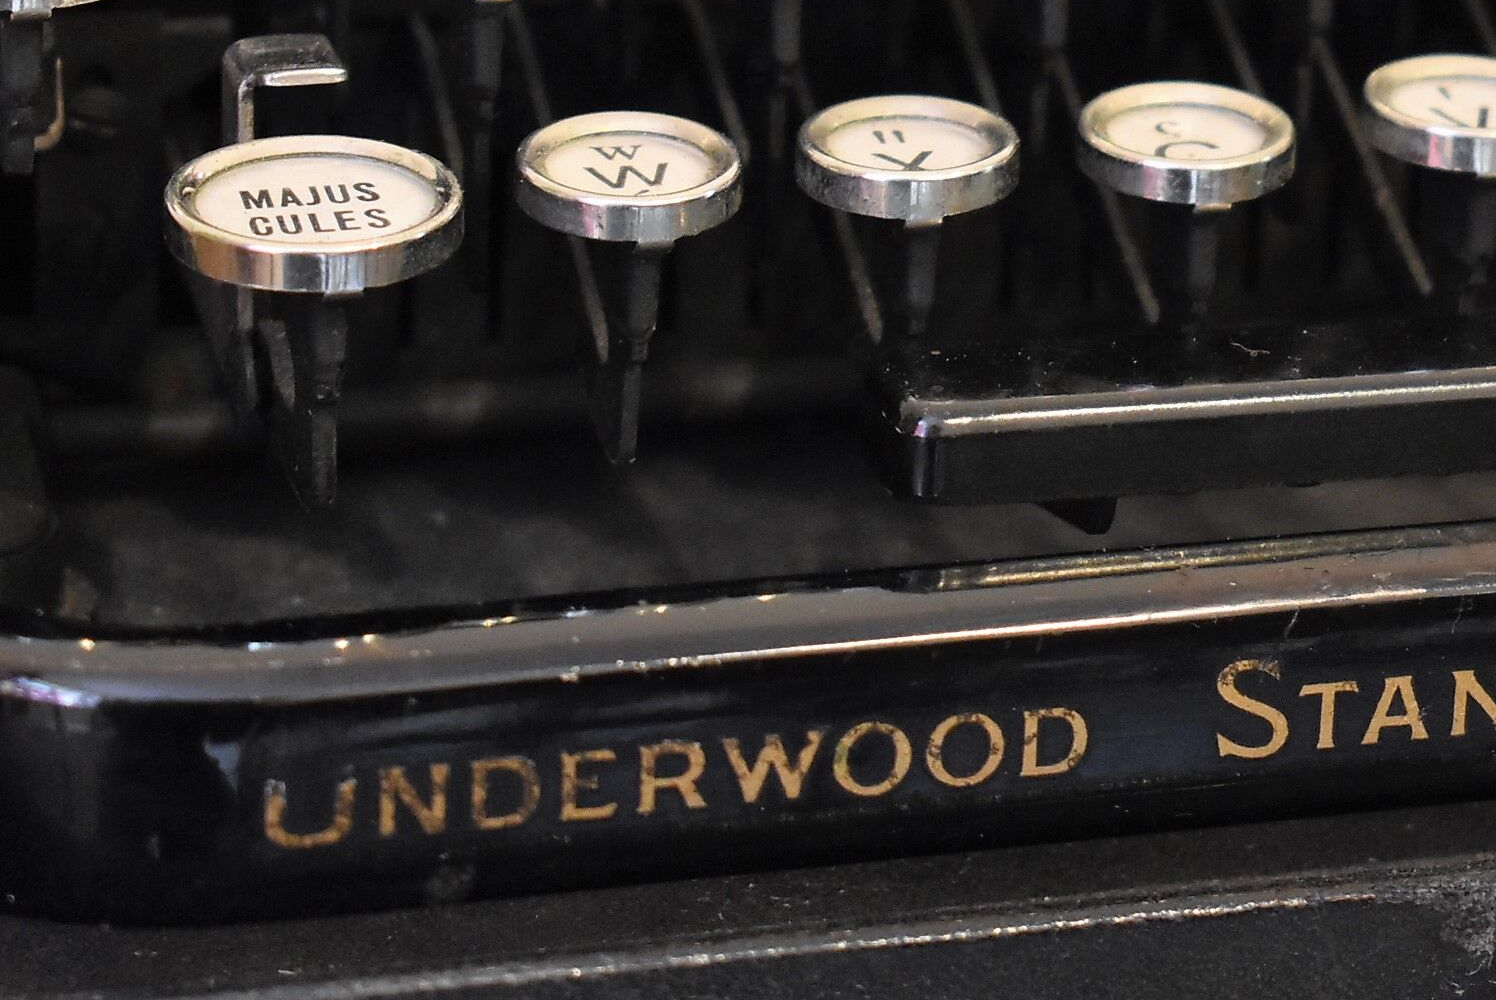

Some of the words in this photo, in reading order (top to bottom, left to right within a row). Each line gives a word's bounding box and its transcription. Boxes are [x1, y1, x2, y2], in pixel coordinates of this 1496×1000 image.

[582, 162, 669, 189] W
[238, 182, 381, 210] MAJUS
[248, 208, 392, 237] CULES
[264, 706, 1089, 850] UNDERWOOD
